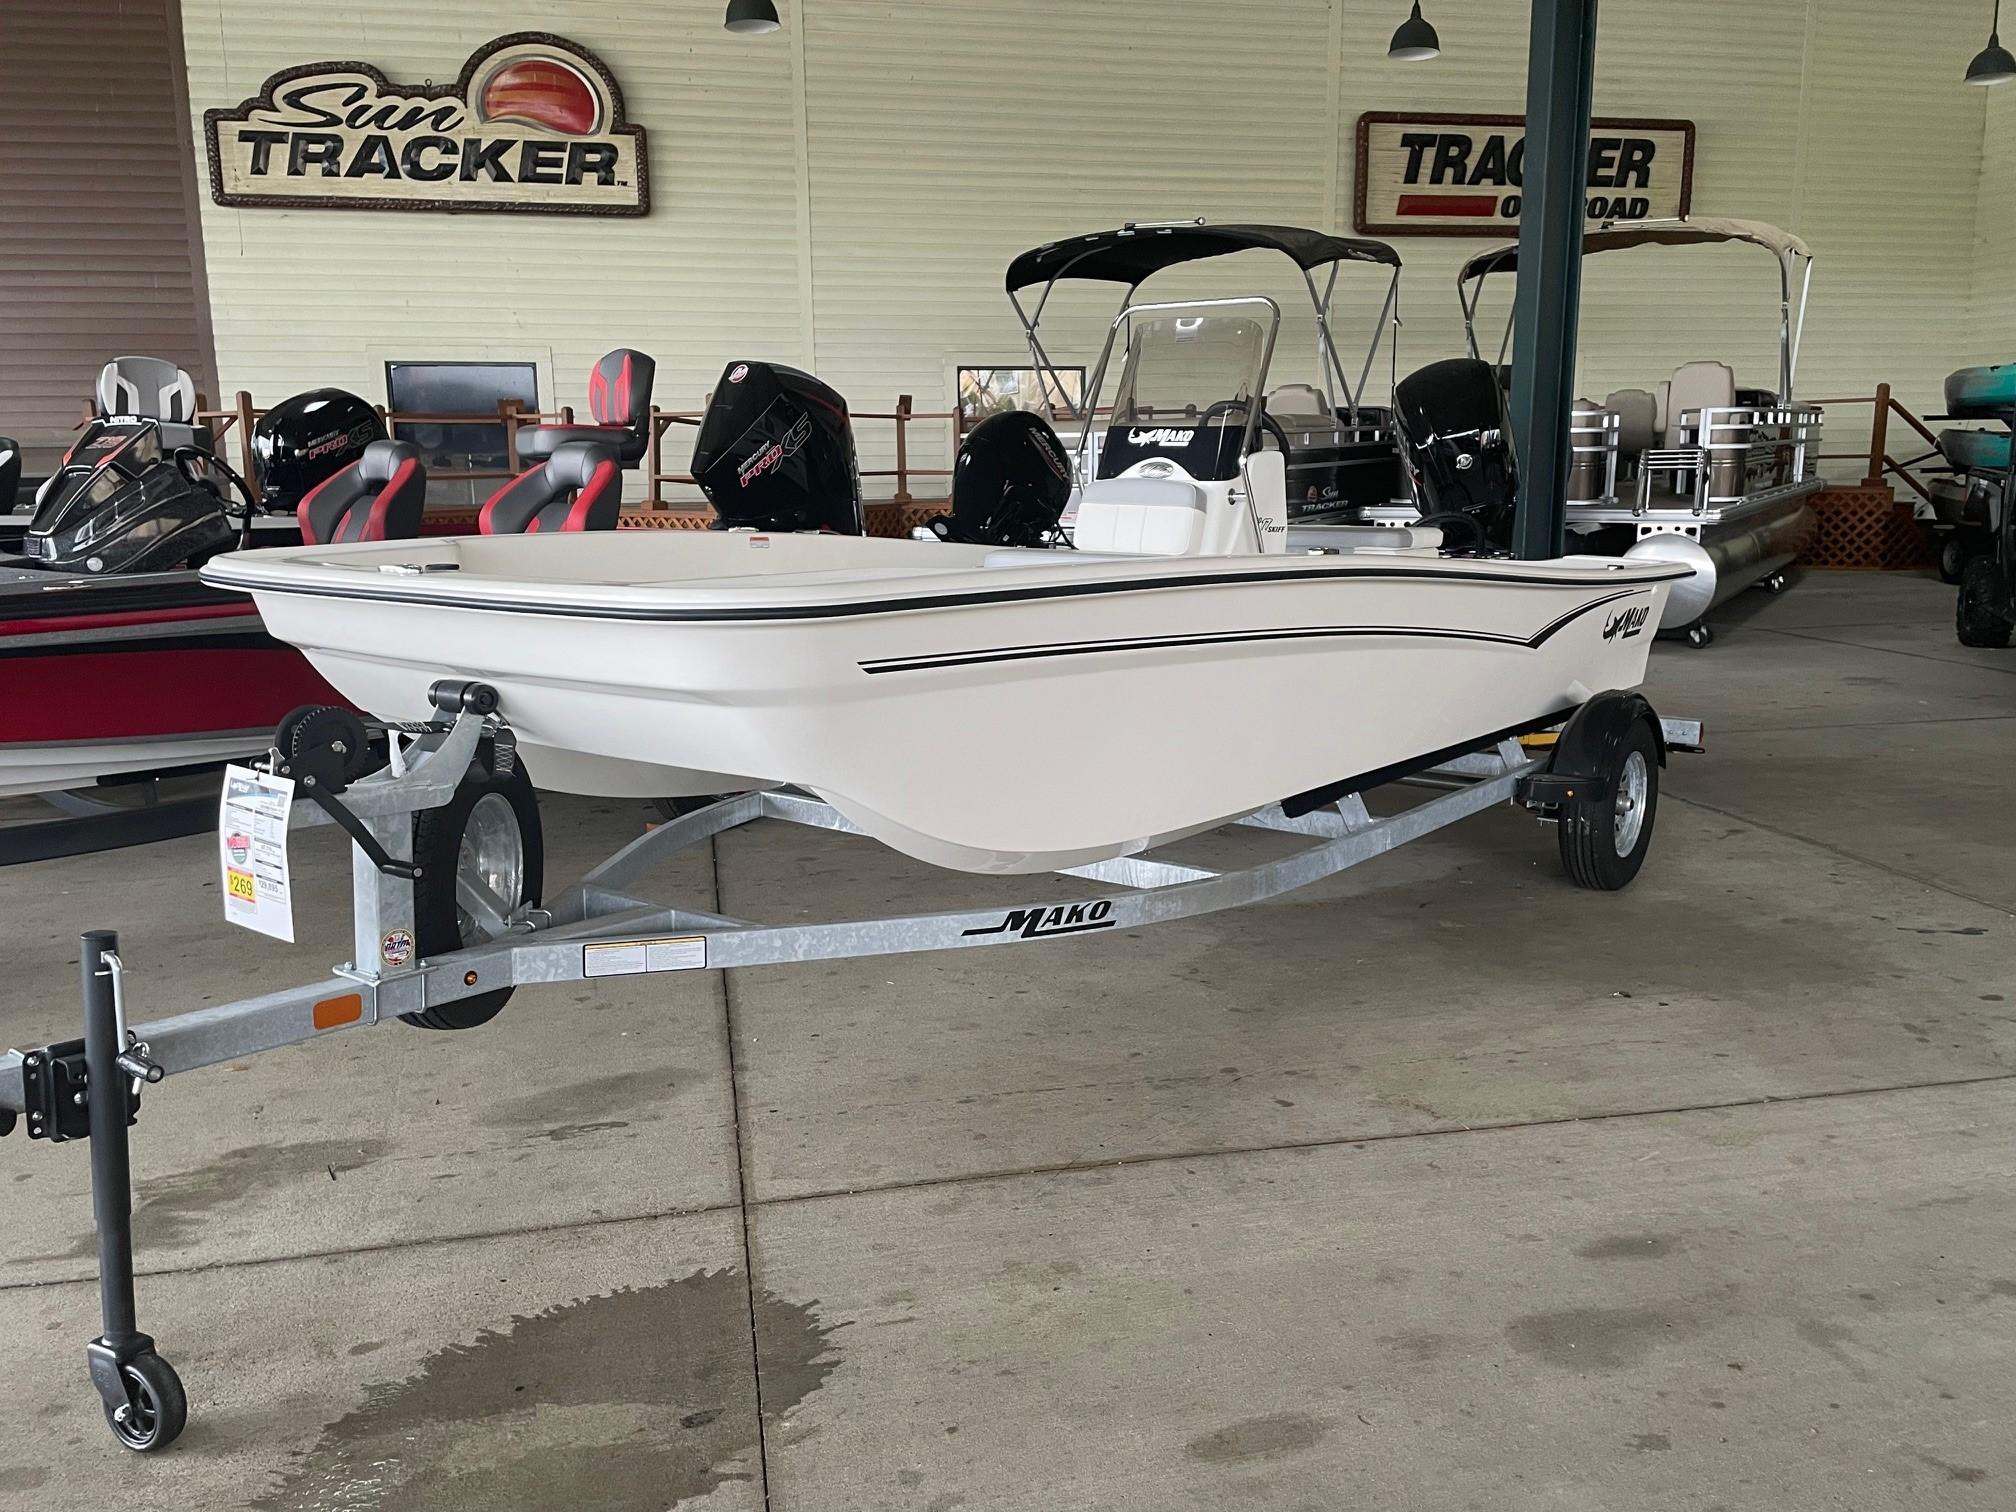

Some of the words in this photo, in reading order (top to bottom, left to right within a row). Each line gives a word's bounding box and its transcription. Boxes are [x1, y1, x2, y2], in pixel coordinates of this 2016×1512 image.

[258, 83, 464, 132] Sun
[238, 130, 620, 185] TRACKER
[1400, 133, 1656, 189] TRAER
[1584, 195, 1650, 219] OAD
[109, 415, 138, 425] NITRO
[1149, 428, 1195, 447] MAKO
[737, 440, 770, 475] MERCURY
[1028, 427, 1071, 480] MERCURY
[1301, 500, 1349, 513] TRACKER
[1617, 606, 1650, 640] MAKO
[961, 900, 1117, 938] MAKO
